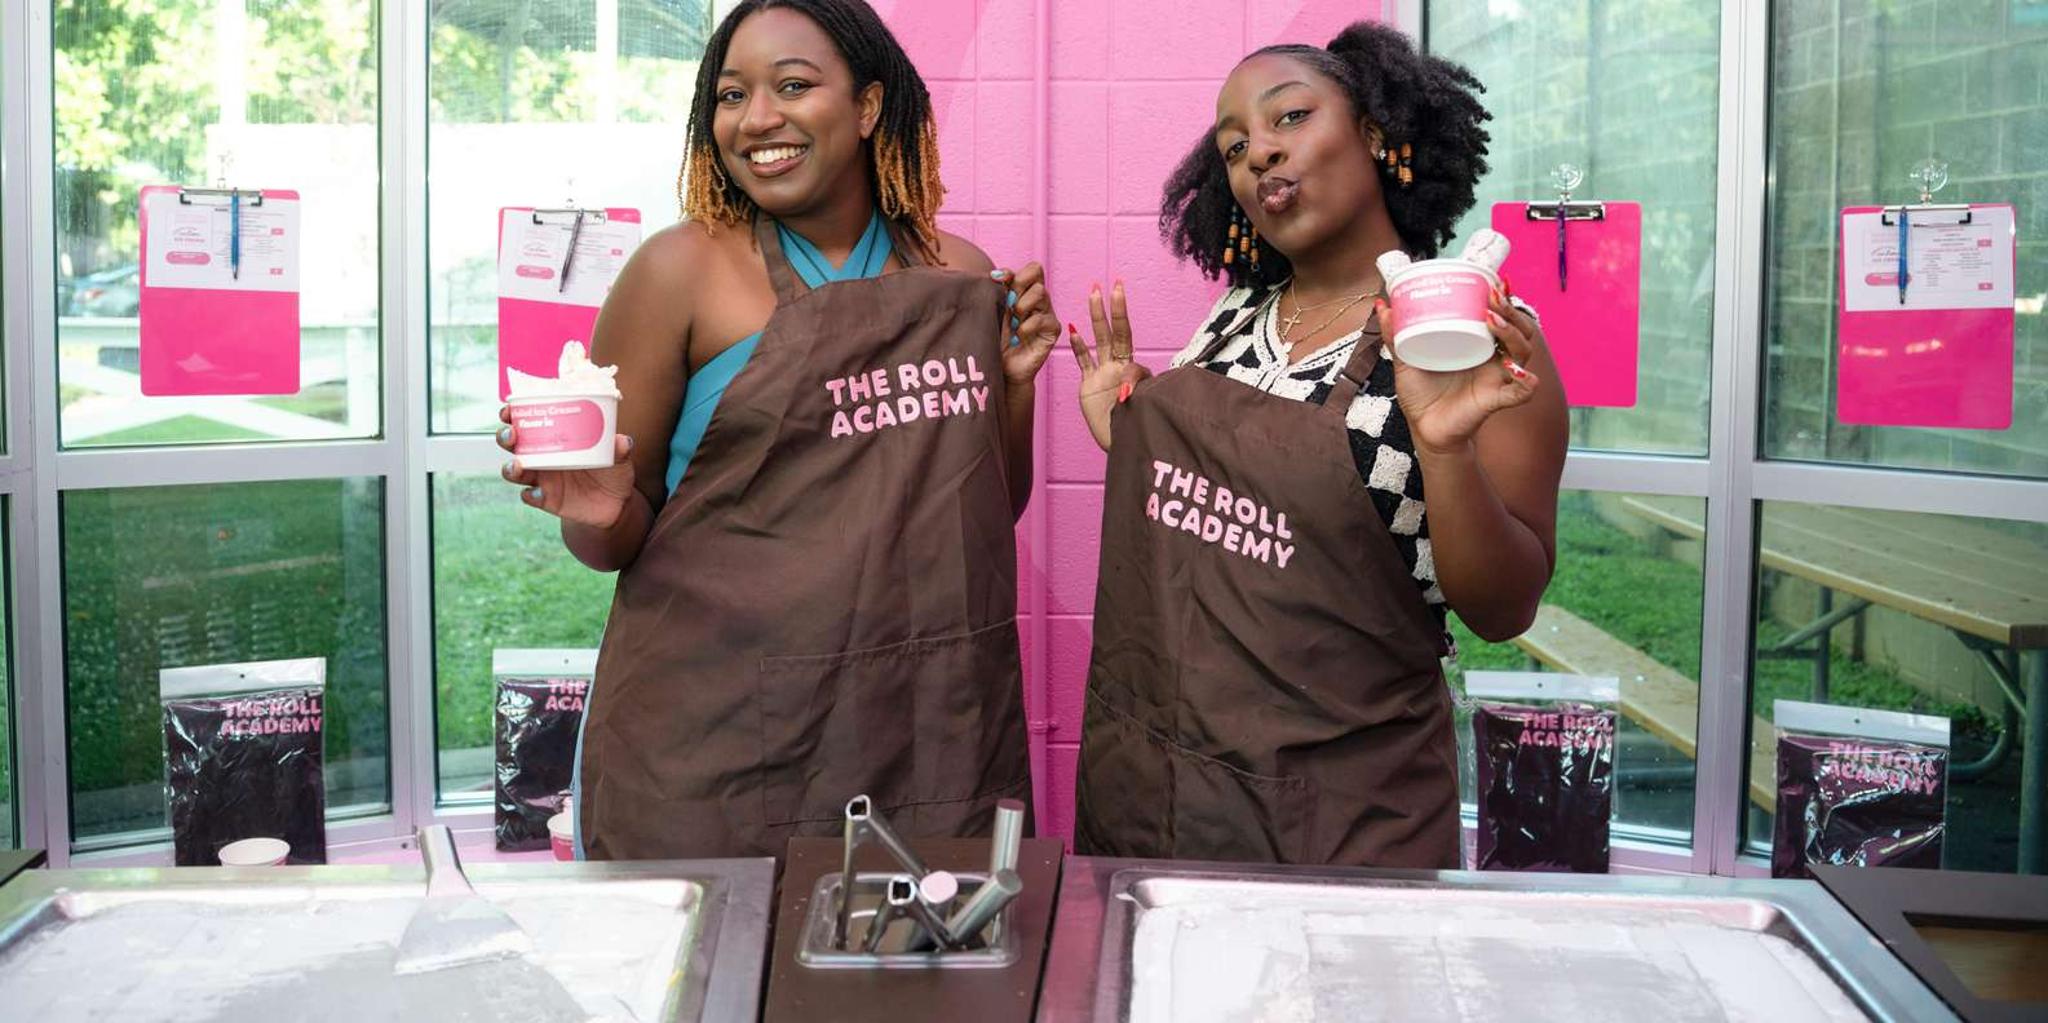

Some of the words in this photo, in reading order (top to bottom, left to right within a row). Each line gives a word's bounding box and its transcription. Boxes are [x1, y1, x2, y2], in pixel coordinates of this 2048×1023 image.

[825, 368, 891, 406] THE
[898, 355, 984, 391] ROLL
[831, 386, 989, 438] ACADEMY
[1153, 460, 1209, 505] THE
[1214, 486, 1292, 540] ROLL
[1146, 492, 1295, 569] ACADEMY
[547, 680, 587, 695] THE
[223, 700, 264, 718] THE
[269, 697, 321, 717] ROLL
[221, 716, 322, 736] ACADEMY
[1521, 713, 1559, 729] THE
[1829, 742, 1873, 763] THE
